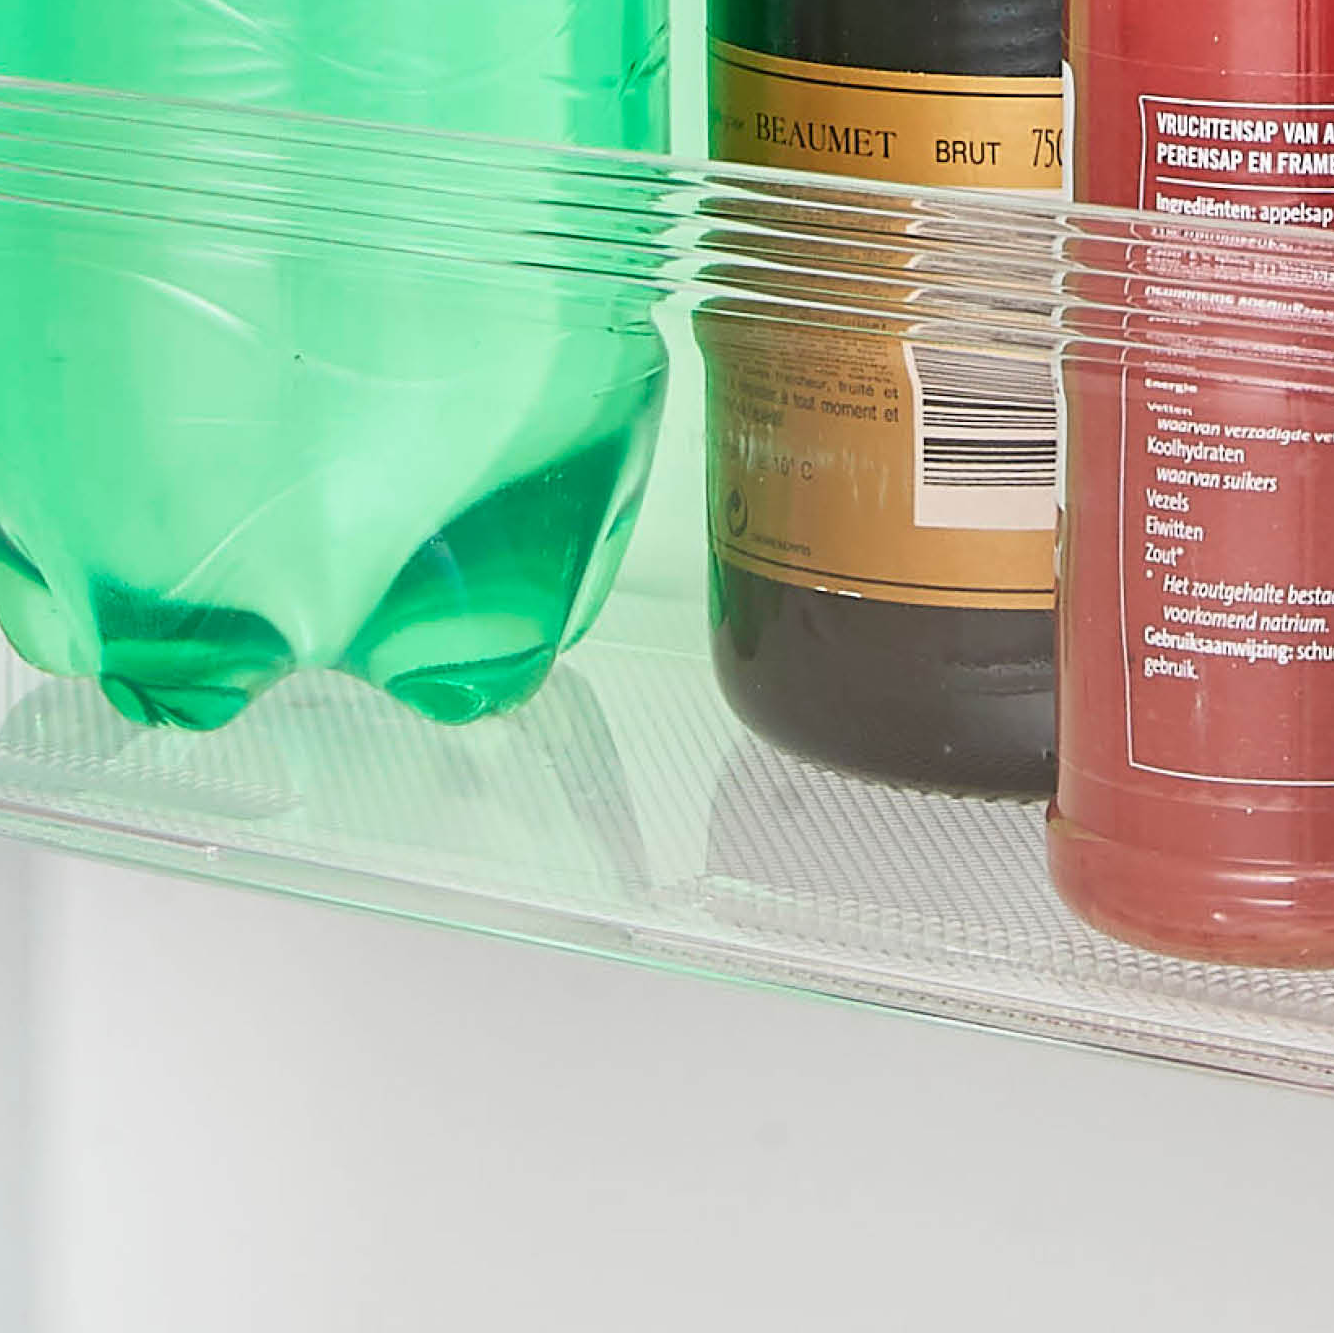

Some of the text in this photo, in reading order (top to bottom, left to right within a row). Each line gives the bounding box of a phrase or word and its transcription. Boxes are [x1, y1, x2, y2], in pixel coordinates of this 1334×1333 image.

[755, 113, 897, 159] BEAUMET
[1156, 112, 1278, 144] VRUCHTENSAP
[1283, 123, 1318, 144] VAN
[935, 141, 1001, 165] BRUT
[1157, 143, 1243, 171] PERENSAP
[1249, 151, 1272, 173] EN
[1156, 192, 1256, 221] Ingrediënten:
[1259, 204, 1333, 225] appelsap
[821, 399, 877, 421] moment
[883, 408, 899, 423] et
[1157, 418, 1220, 436] waarvan
[1225, 423, 1310, 444] verzadigde
[1147, 436, 1244, 464] Koolhydraten
[1156, 467, 1220, 488] waarvan
[1222, 471, 1277, 493] suikers
[1146, 489, 1190, 513] Vezels
[1146, 515, 1203, 541] Eiwitten
[1163, 575, 1188, 594] Het
[1192, 578, 1284, 605] zoutgehalte
[1163, 604, 1330, 633] voorkomend natrium.
[1144, 627, 1294, 665] Gebruiksaanwijzing:
[1144, 657, 1199, 680] gebruik.
